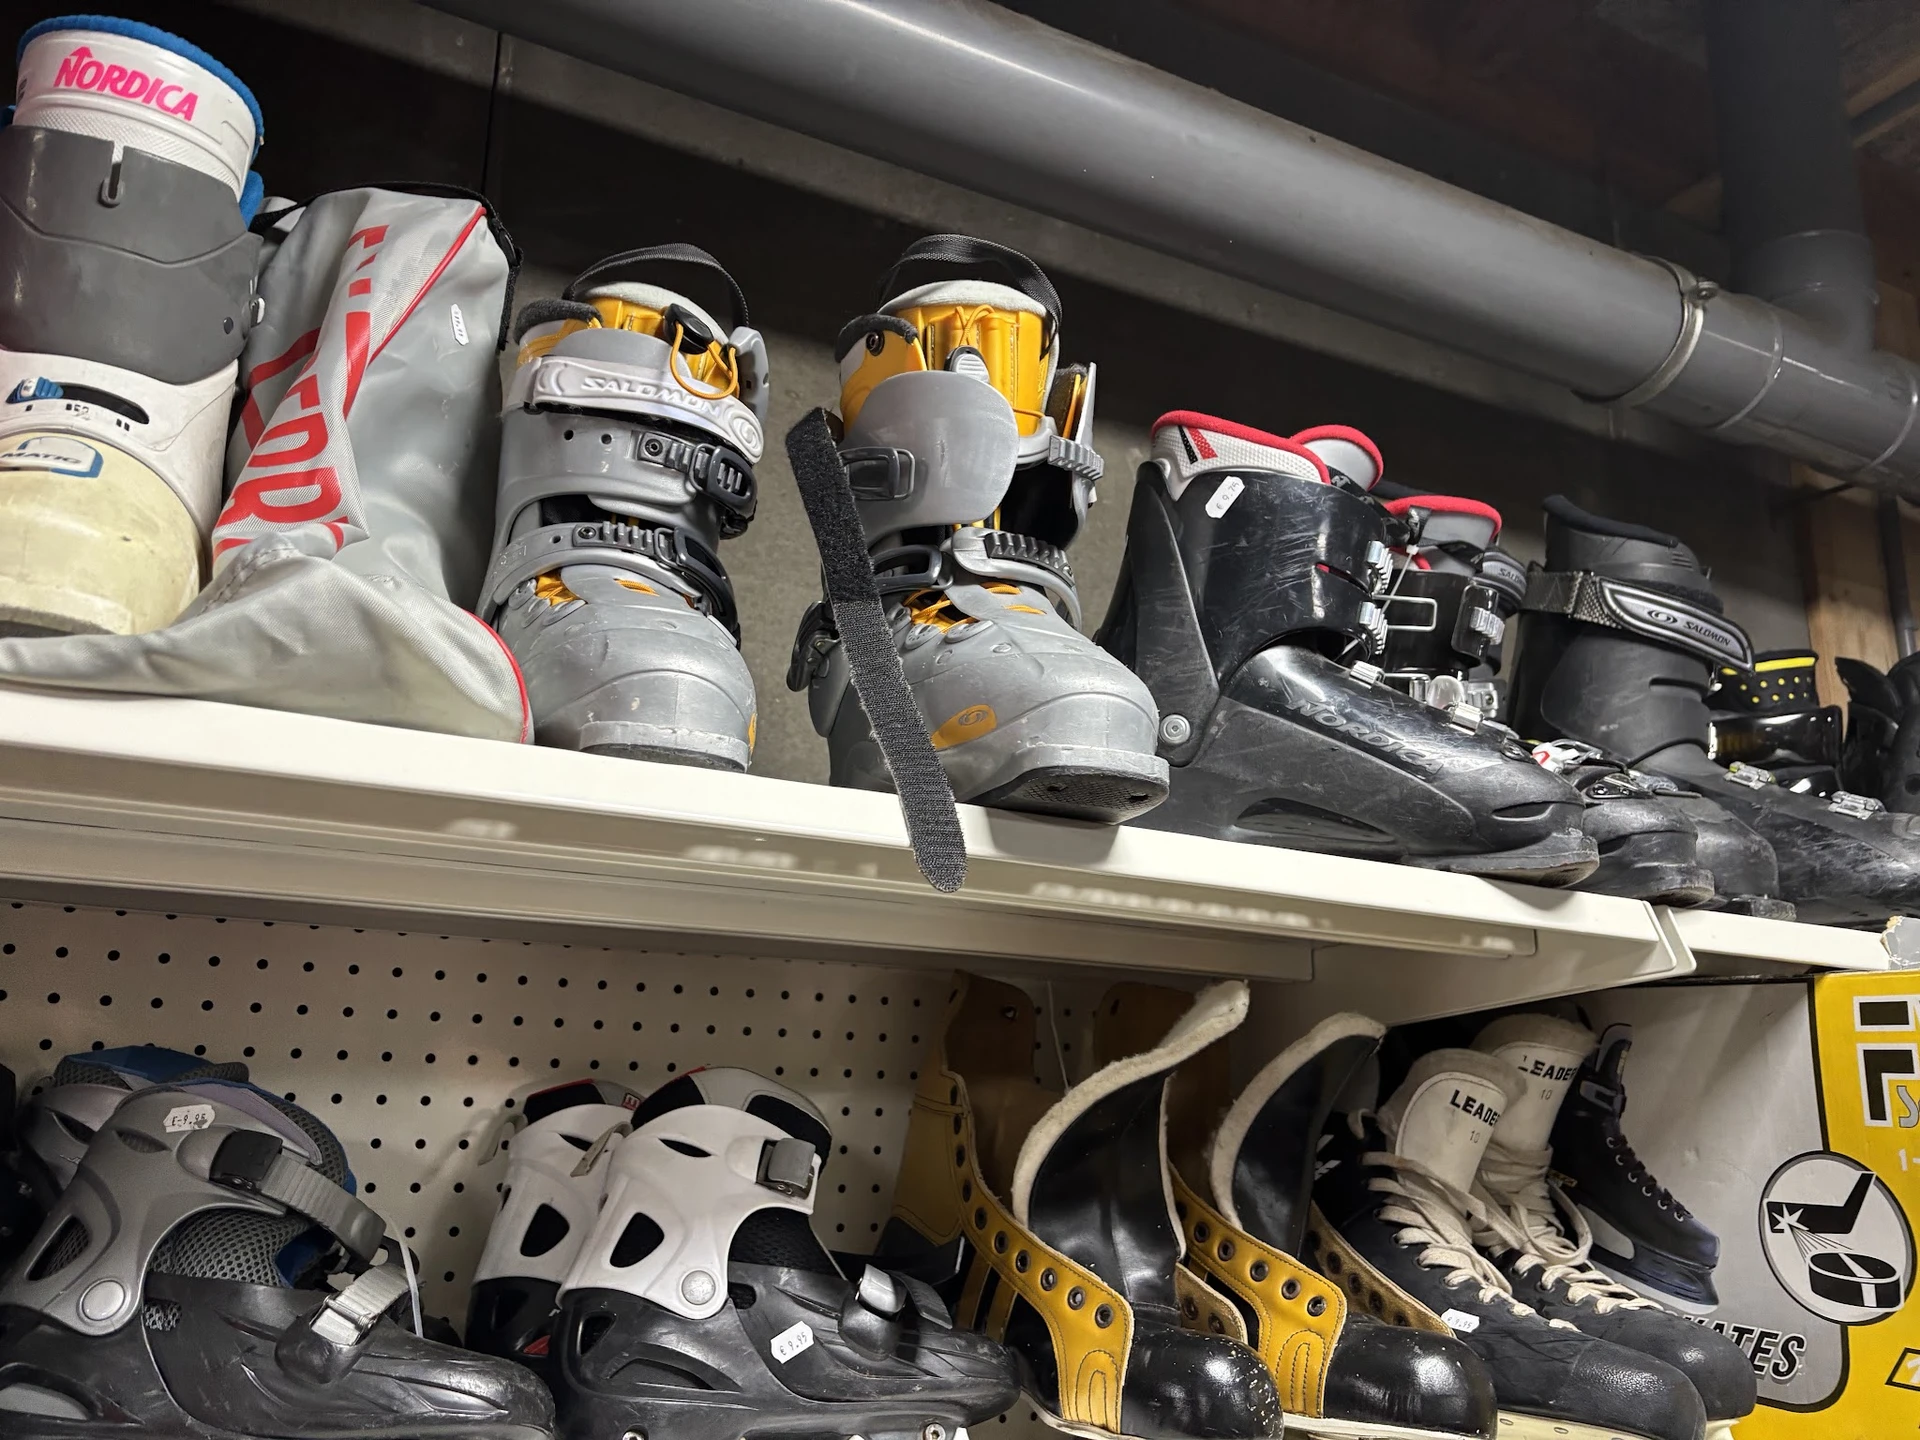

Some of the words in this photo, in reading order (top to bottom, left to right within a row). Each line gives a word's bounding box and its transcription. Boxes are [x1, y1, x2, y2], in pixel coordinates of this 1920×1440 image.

[53, 46, 199, 122] NORDICA
[581, 376, 721, 417] SALOMON
[1684, 621, 1731, 646] SALOMON
[1285, 699, 1444, 776] NORDICA
[1449, 1088, 1500, 1127] LEADE
